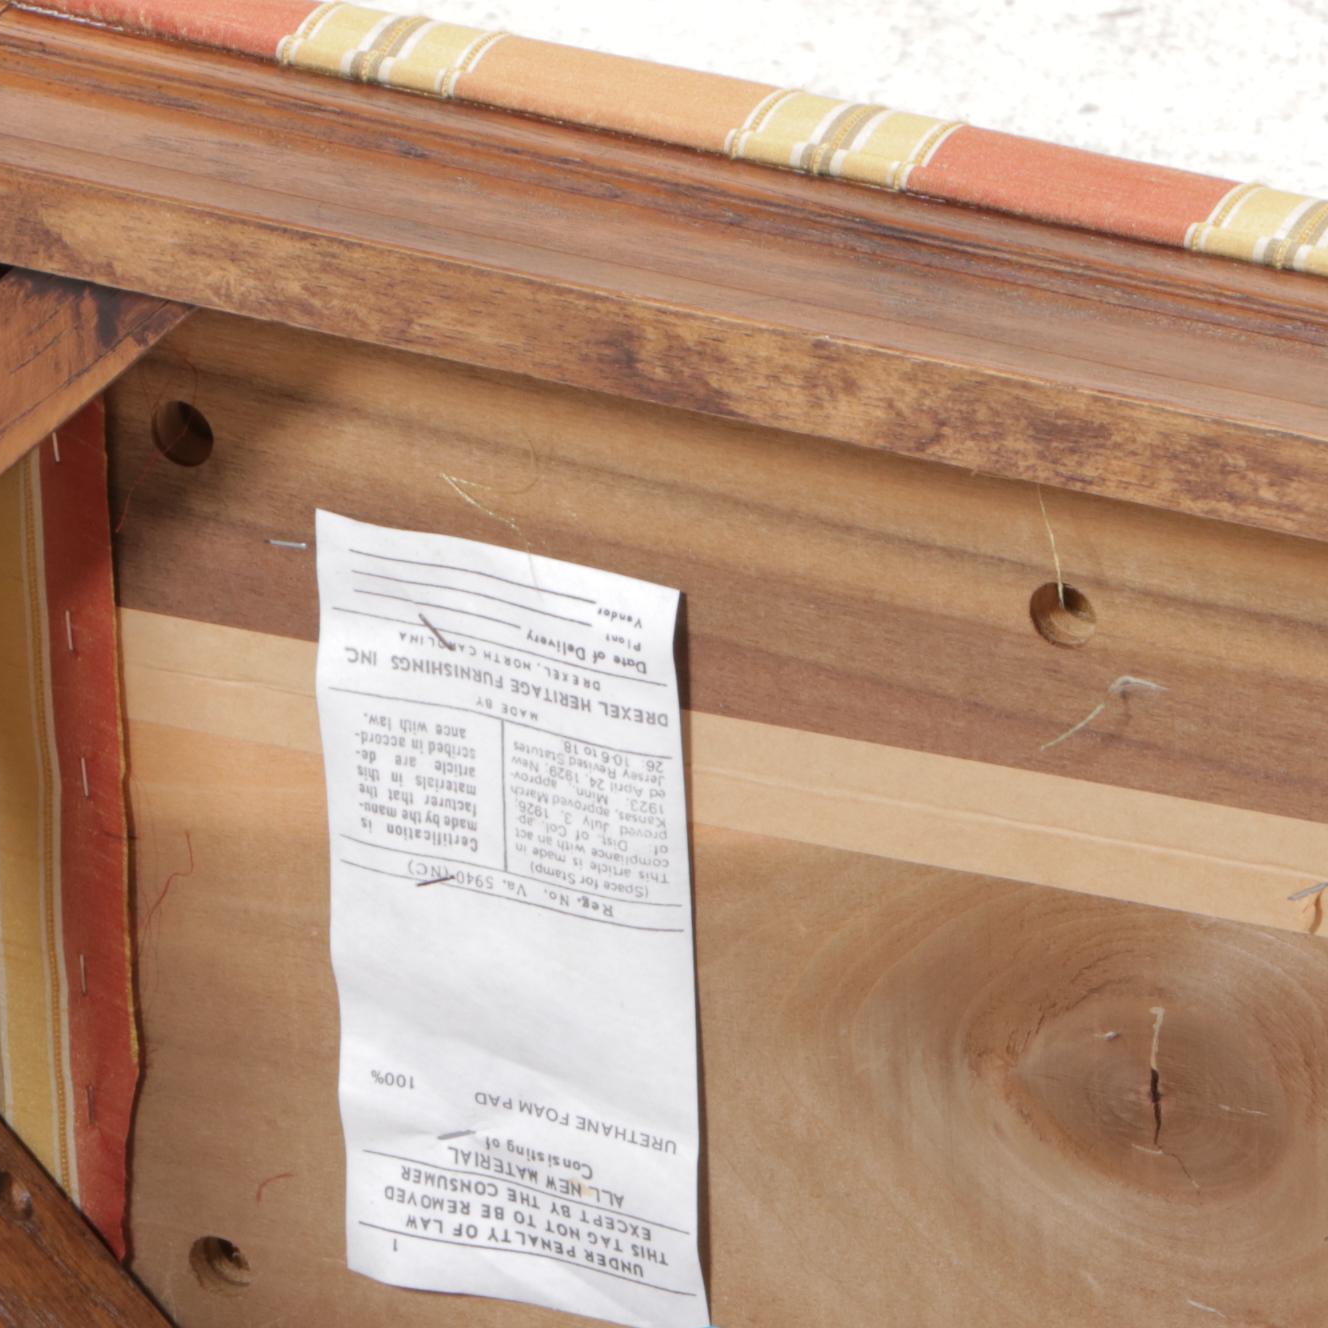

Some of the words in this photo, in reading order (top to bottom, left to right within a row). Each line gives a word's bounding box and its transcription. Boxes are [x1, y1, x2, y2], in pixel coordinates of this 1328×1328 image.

[598, 608, 642, 628] Vendor
[527, 630, 585, 660] Delivery
[606, 634, 641, 652] Plant
[484, 651, 531, 670] NORTH
[593, 651, 605, 663] of
[614, 656, 646, 674] Date
[391, 656, 503, 689] FURNISHINGS
[538, 663, 600, 691] DREXEL,
[476, 697, 492, 709] BY
[510, 678, 591, 712] HERITAGE
[502, 704, 538, 720] MADE
[599, 701, 668, 727] DREXEL
[364, 713, 391, 731] law.
[400, 719, 427, 735] with
[355, 731, 405, 748] accord-
[436, 724, 466, 739] ance
[411, 739, 423, 754] in
[428, 741, 475, 759] scribed
[514, 741, 565, 765] Statutes
[584, 746, 597, 758] to
[356, 750, 376, 764] de-
[395, 755, 416, 767] are
[512, 756, 539, 773] New
[357, 765, 379, 782] this
[435, 760, 475, 777] article
[569, 757, 616, 779] Revised
[391, 772, 402, 787] in
[416, 775, 476, 796] materials
[623, 768, 664, 787] Jersey
[359, 783, 377, 798] the
[388, 789, 413, 805] that
[511, 786, 548, 804] March
[610, 782, 643, 797] April
[650, 789, 666, 799] ed
[360, 802, 396, 817] manu-
[424, 795, 477, 817] facturer
[552, 795, 610, 817] approved
[361, 817, 372, 832] is
[402, 809, 421, 824] the
[425, 811, 440, 828] by
[444, 816, 477, 832] made
[583, 815, 609, 832] July
[387, 824, 478, 852] Certification
[516, 828, 533, 840] act
[538, 835, 552, 845] an
[576, 830, 589, 841] of
[620, 825, 667, 845] proved
[516, 844, 526, 853] in
[533, 848, 565, 862] made
[557, 840, 585, 853] with
[573, 858, 582, 866] is
[591, 848, 669, 872] compliance
[530, 862, 576, 884] Stamp)
[590, 861, 631, 877] article
[639, 871, 669, 884] This
[503, 880, 527, 897] Va.
[580, 876, 598, 890] for
[603, 881, 648, 898] (Space
[544, 889, 569, 906] No.
[577, 896, 613, 917] Reg.
[371, 1070, 414, 1089] 100%
[475, 1092, 512, 1110] PAD
[518, 1100, 569, 1126] FOAM
[486, 1137, 499, 1148] of
[576, 1116, 676, 1155] URETHANE
[448, 1147, 538, 1184] MATERIAL
[507, 1140, 593, 1180] Consisting
[402, 1166, 498, 1197] CONSUMER
[546, 1176, 582, 1197] NEW
[385, 1186, 470, 1215] REMOVED
[507, 1188, 538, 1209] THE
[589, 1187, 624, 1208] ALL
[482, 1204, 504, 1220] BE
[551, 1202, 571, 1218] BY
[406, 1216, 443, 1234] LAW
[514, 1211, 535, 1228] TO
[580, 1210, 651, 1241] EXCEPT
[453, 1224, 478, 1239] OF
[545, 1220, 579, 1240] NOT
[393, 1239, 397, 1251] 1
[488, 1228, 576, 1258] PENALTY
[587, 1232, 622, 1252] TAG
[584, 1250, 643, 1277] UNDER
[631, 1244, 668, 1266] THIS
